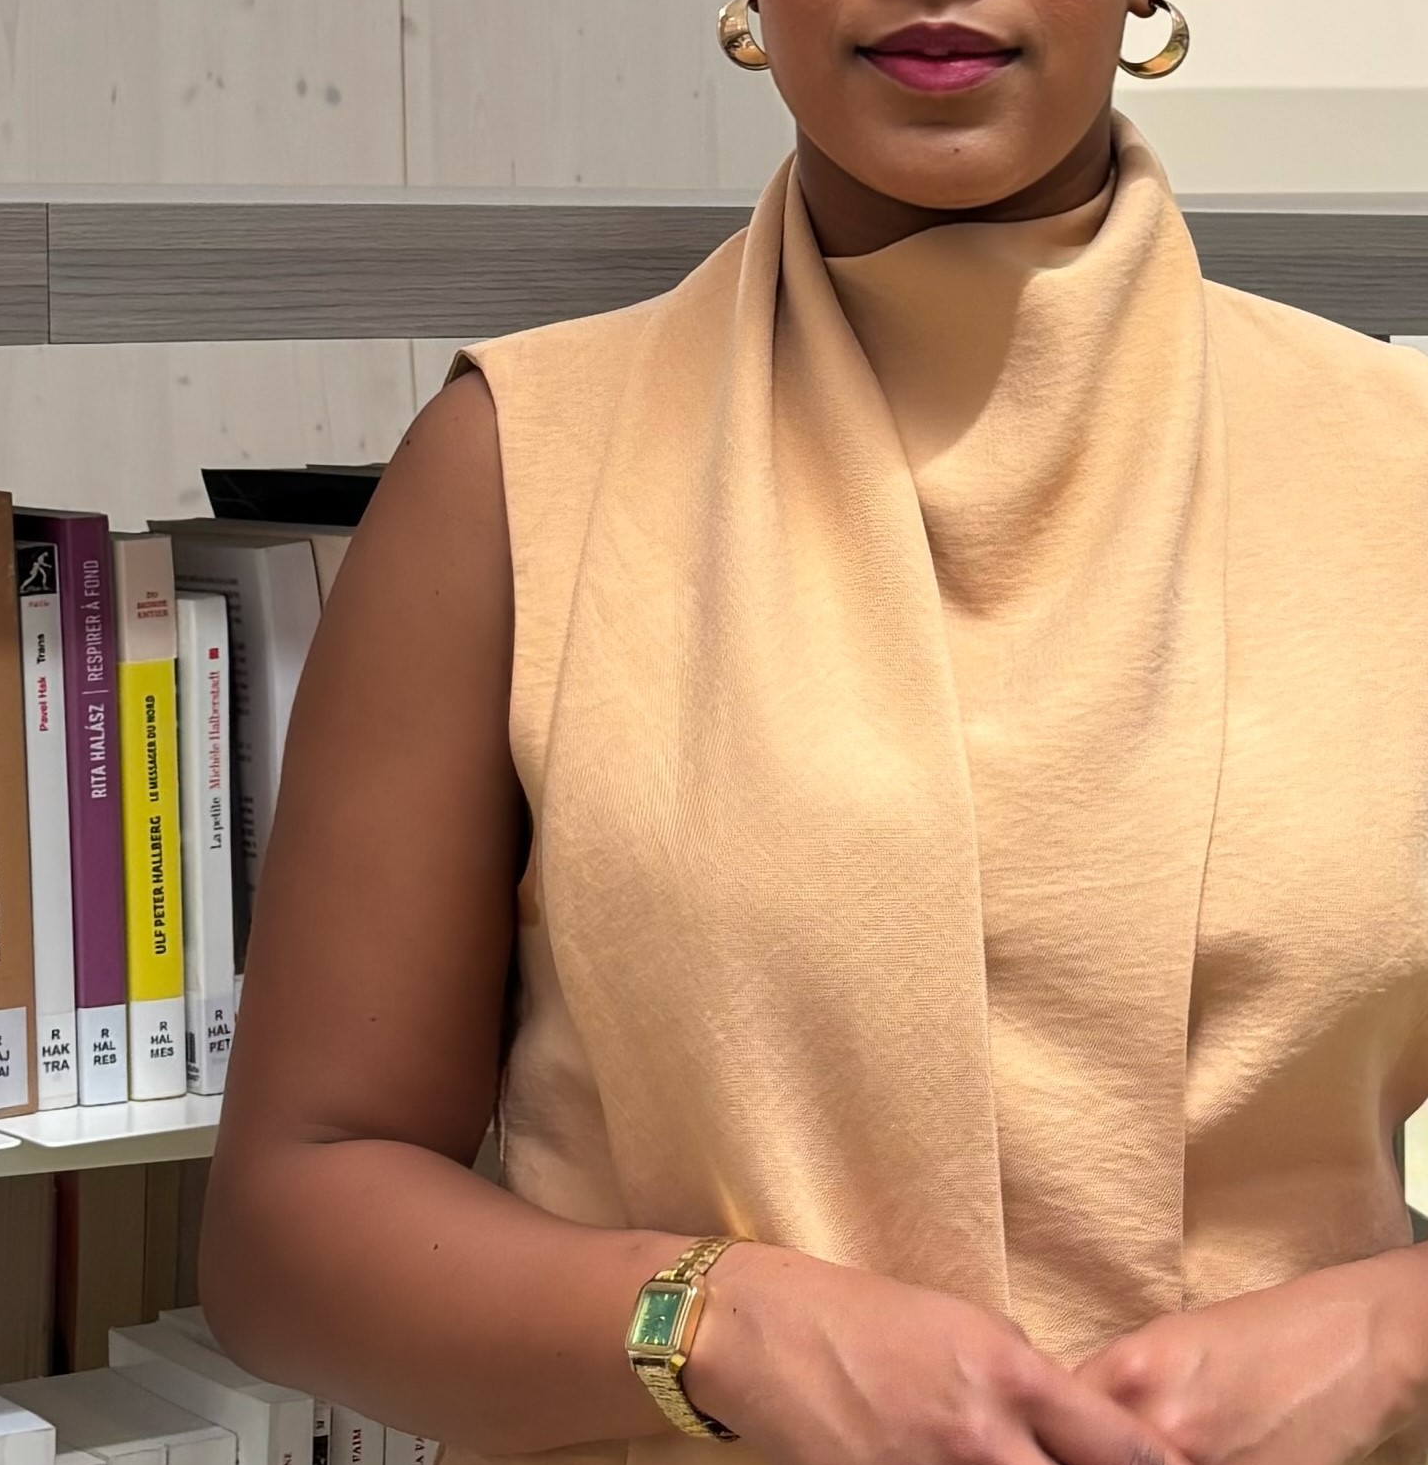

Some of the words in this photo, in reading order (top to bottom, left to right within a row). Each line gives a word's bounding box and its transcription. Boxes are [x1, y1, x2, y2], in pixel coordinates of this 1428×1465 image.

[82, 560, 100, 596] FOND
[81, 600, 101, 610] À
[84, 615, 104, 681] RESPIRER
[84, 703, 106, 761] HALÁSZ
[89, 765, 108, 798] RITA
[149, 816, 163, 883] HALLBERG
[151, 886, 165, 927] PETER
[154, 930, 167, 954] ULF
[42, 1043, 69, 1057] HAK
[43, 1060, 69, 1073] TRA
